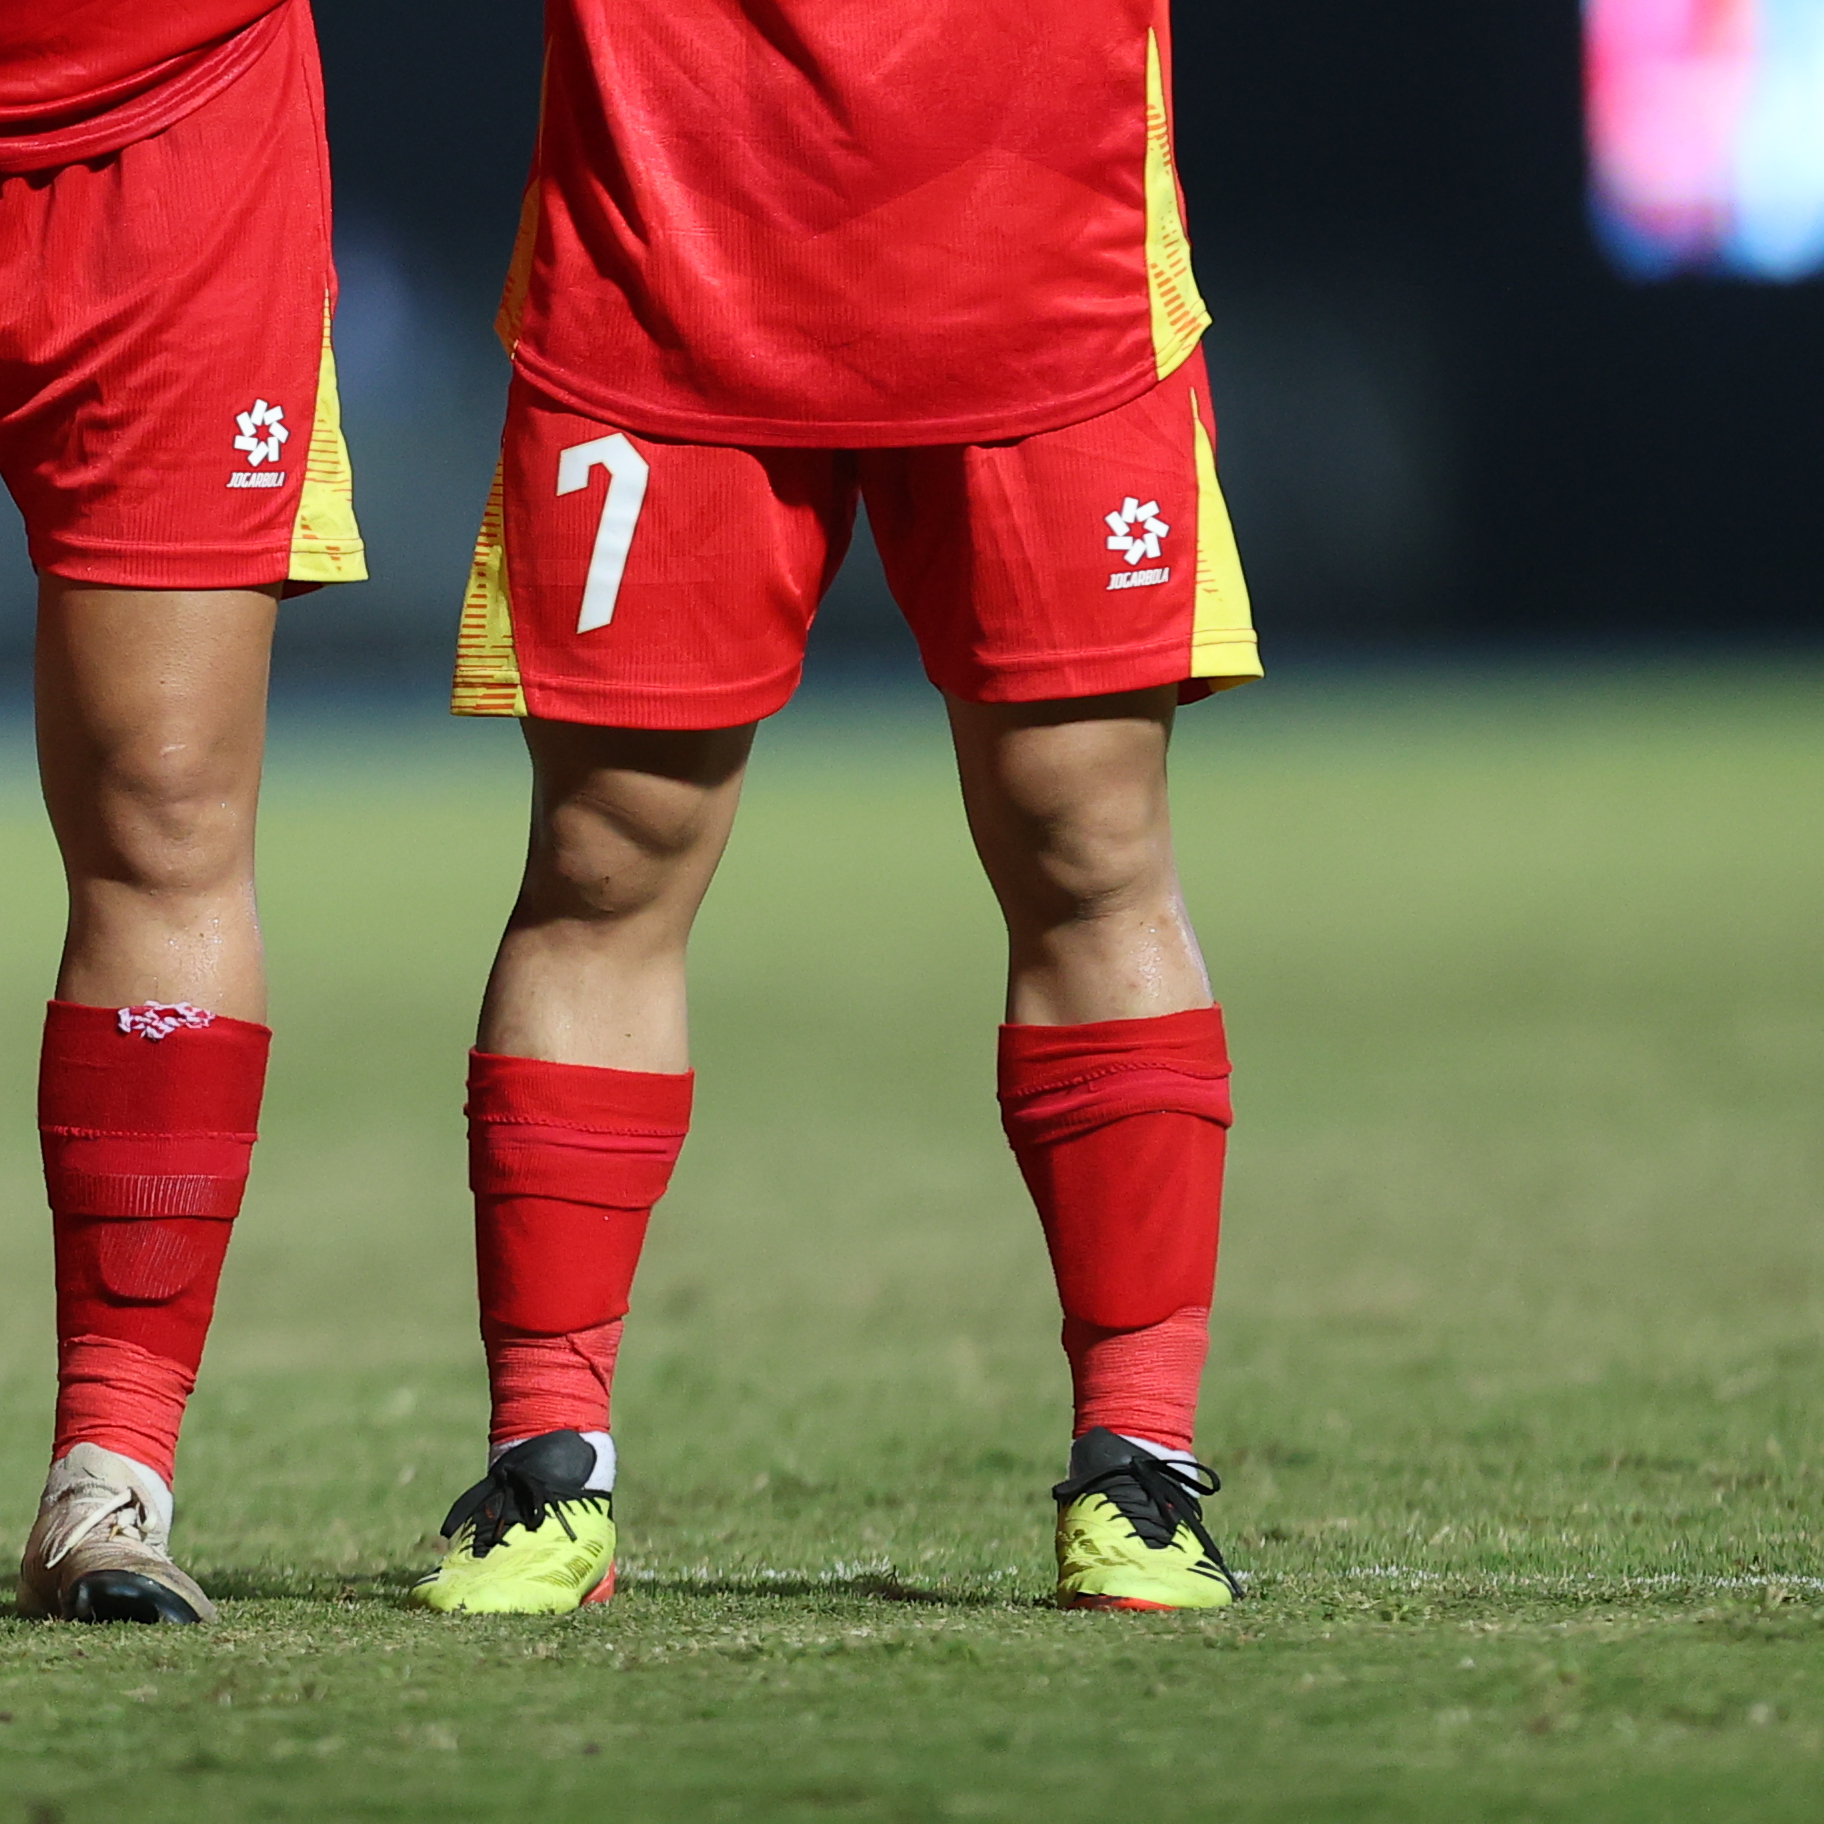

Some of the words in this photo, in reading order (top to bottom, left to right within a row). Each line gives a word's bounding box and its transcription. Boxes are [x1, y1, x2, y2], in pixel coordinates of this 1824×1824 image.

[225, 470, 286, 489] JOGARBOLA
[555, 431, 651, 635] 7
[1105, 565, 1171, 591] JOGARBOLA
